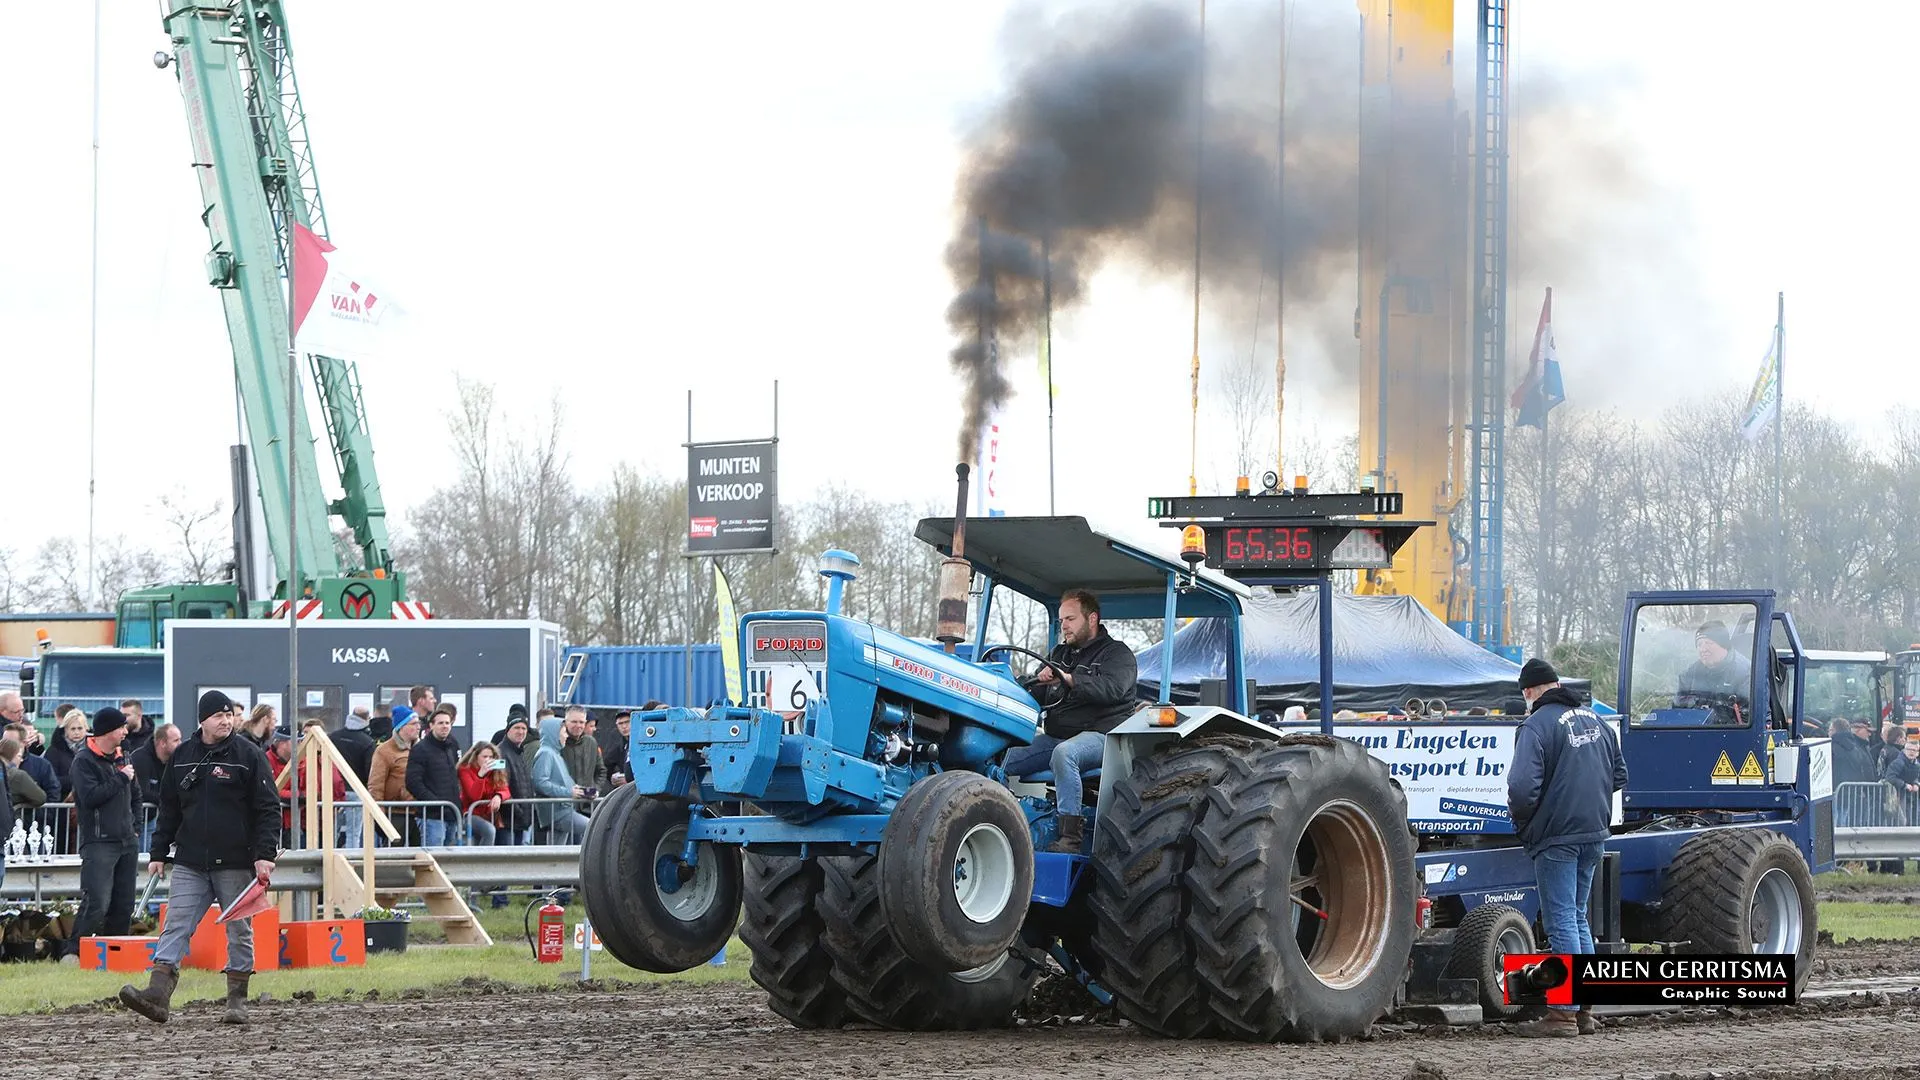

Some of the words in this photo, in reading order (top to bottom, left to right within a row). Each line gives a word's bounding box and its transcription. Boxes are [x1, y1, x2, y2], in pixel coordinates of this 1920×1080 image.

[331, 294, 360, 314] VAN
[700, 456, 760, 476] MUNTEN
[697, 483, 764, 502] VERKOOP
[1227, 528, 1311, 560] 65.36
[756, 637, 824, 651] FORD
[332, 647, 390, 663] KASSA
[893, 657, 934, 680] FORD
[940, 674, 980, 698] 5000
[790, 679, 807, 709] 6
[1395, 729, 1498, 755] Engelen
[1476, 757, 1505, 776] bv
[1408, 786, 1435, 794] transport
[1447, 786, 1474, 794] dieplader
[1475, 786, 1502, 794] transport
[1442, 801, 1455, 811] OP-
[1457, 803, 1468, 813] EN
[1469, 804, 1508, 818] OVERSLAG
[330, 932, 347, 964] 2
